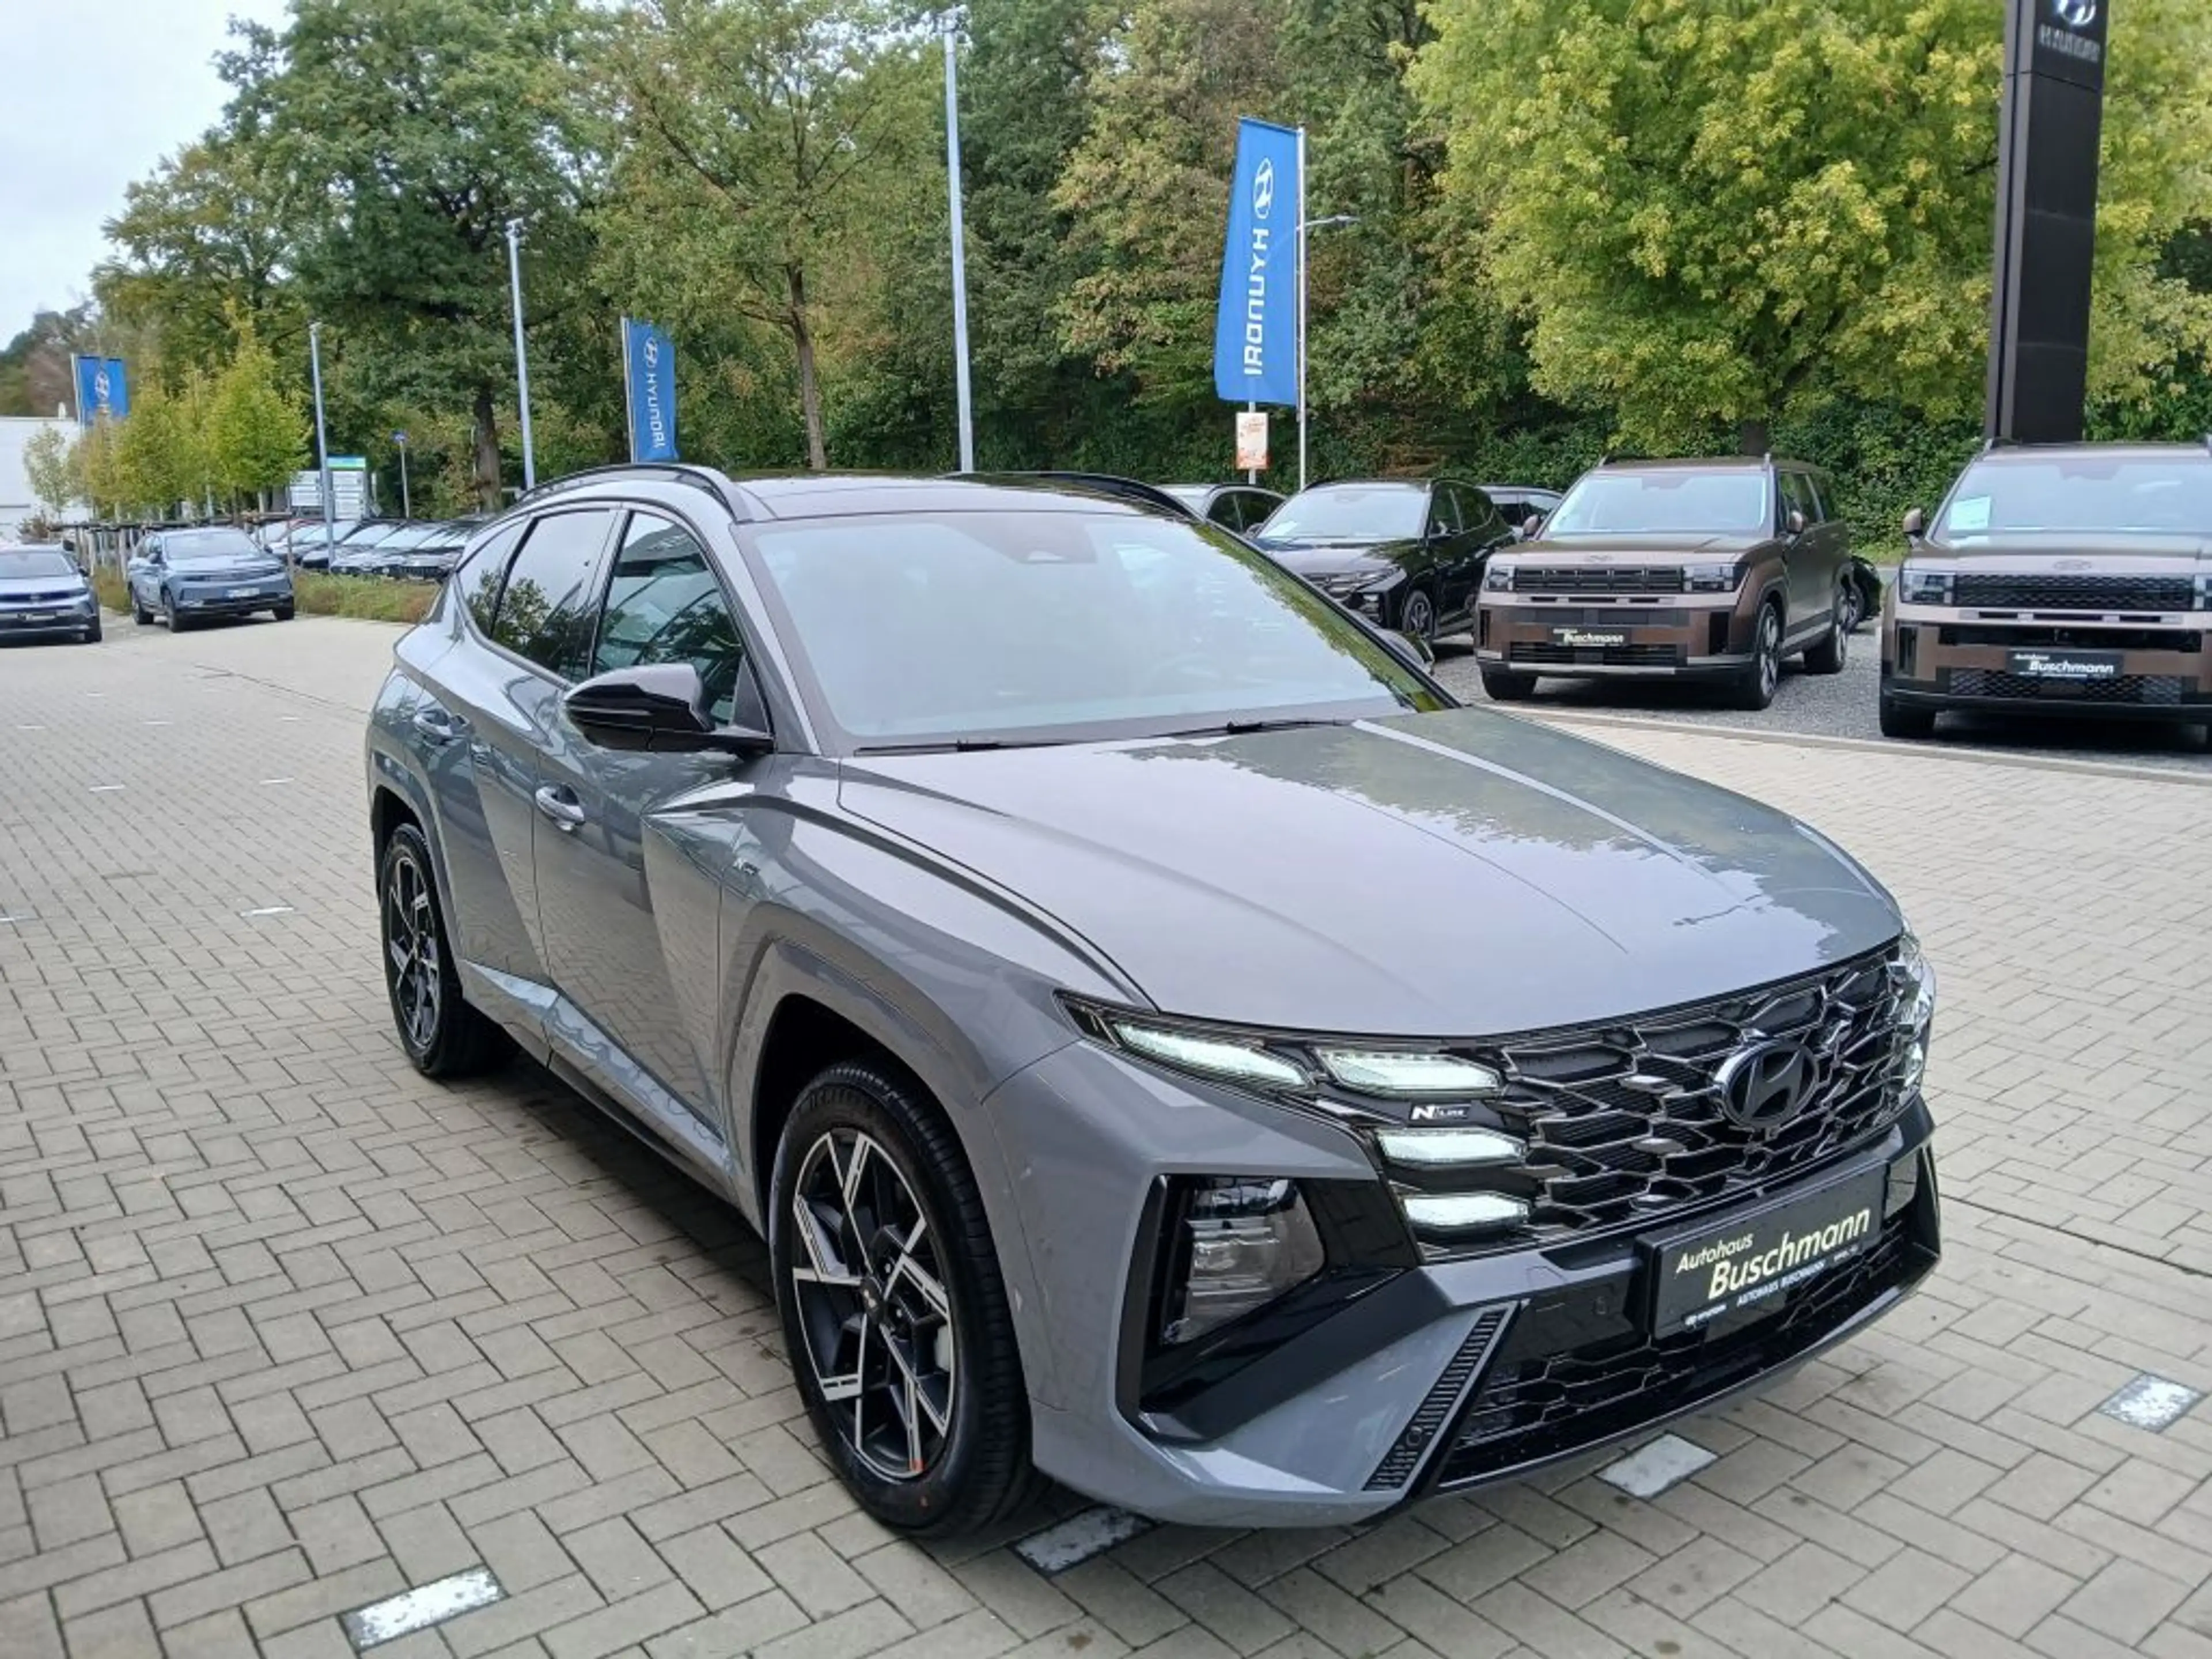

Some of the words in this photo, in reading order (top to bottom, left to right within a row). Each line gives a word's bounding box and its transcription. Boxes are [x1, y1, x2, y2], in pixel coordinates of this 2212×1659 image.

[646, 373, 666, 448] HYUNDAI
[2029, 660, 2114, 675] Buschmann
[1675, 1233, 1754, 1275] Autohaus
[1708, 1208, 1870, 1300] Buschmann
